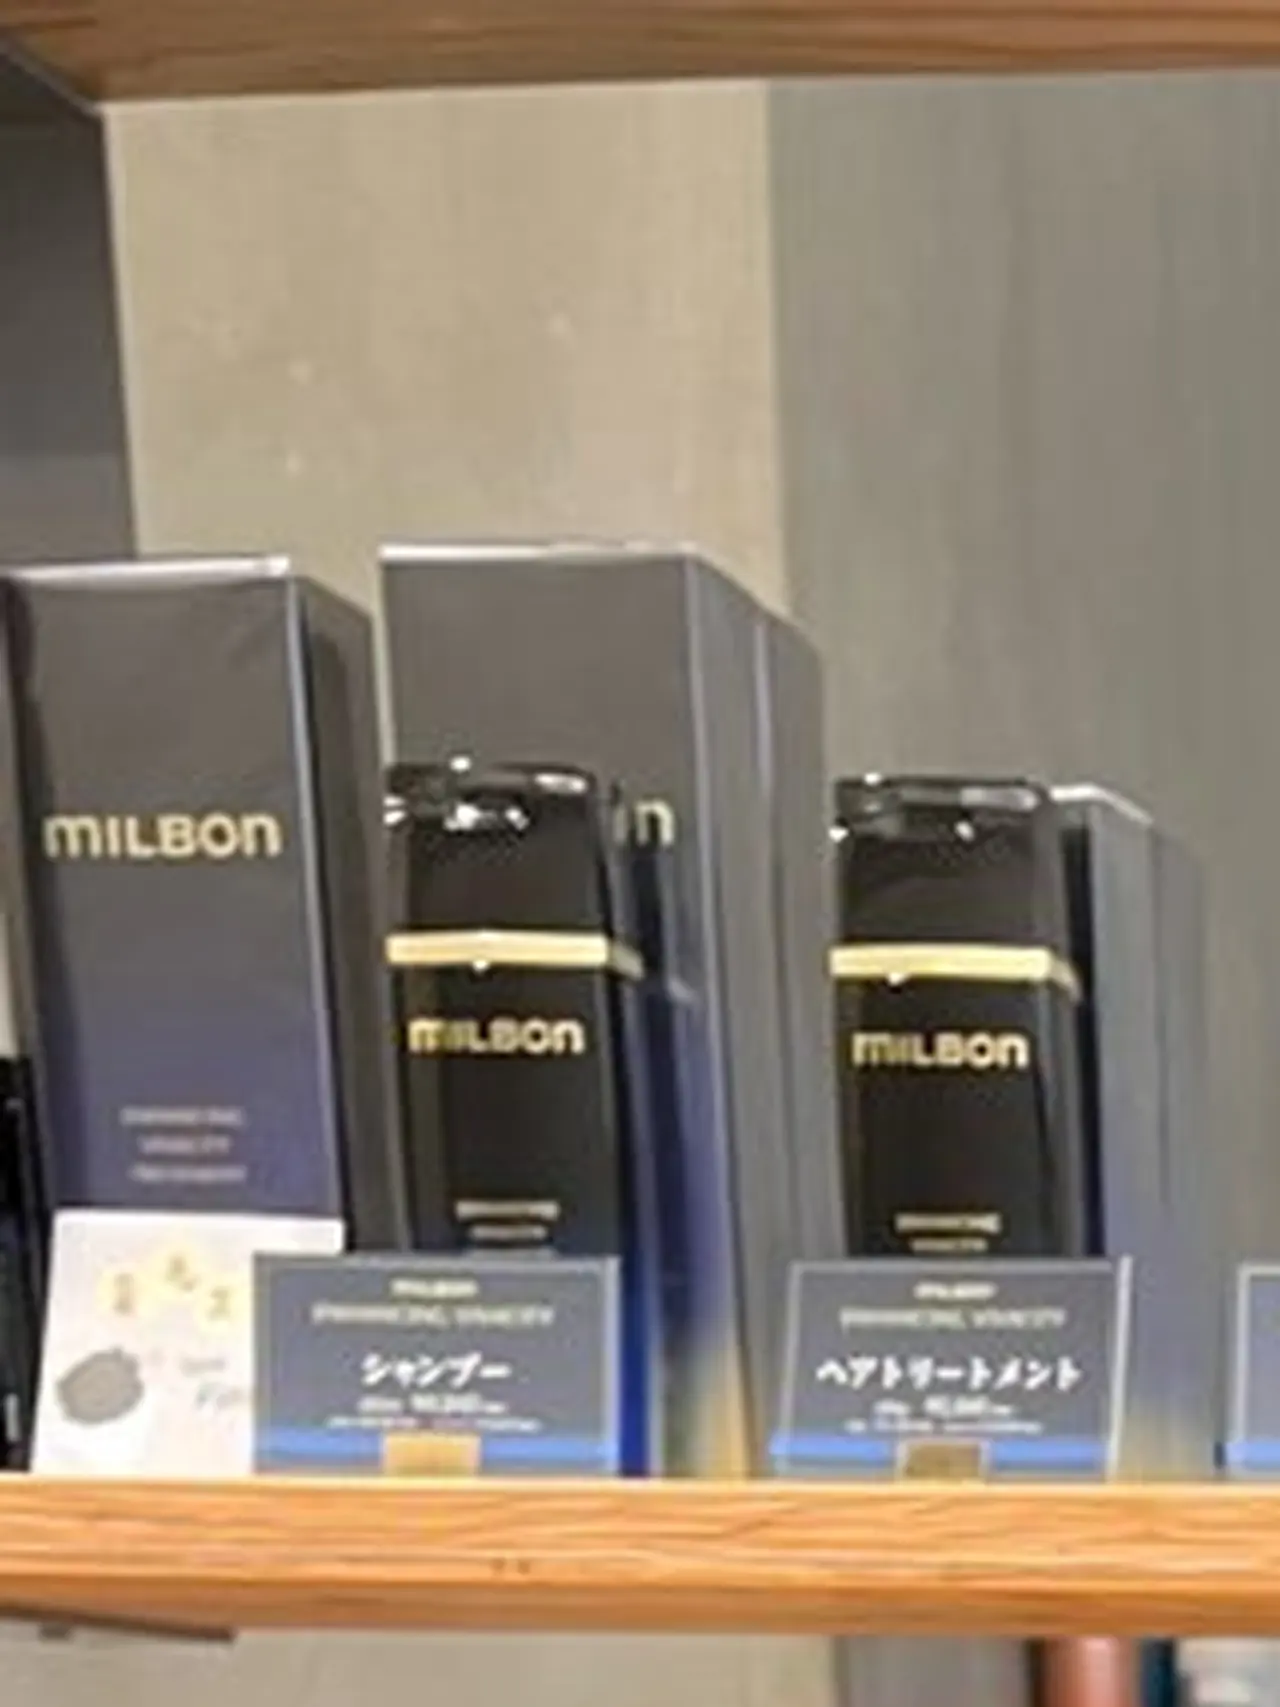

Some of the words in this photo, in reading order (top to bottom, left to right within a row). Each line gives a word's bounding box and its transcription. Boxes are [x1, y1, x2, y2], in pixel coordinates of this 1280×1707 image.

[44, 810, 284, 861] MILBON
[359, 1349, 513, 1388] シャンプー
[814, 1354, 1084, 1392] ヘアトリートメント
